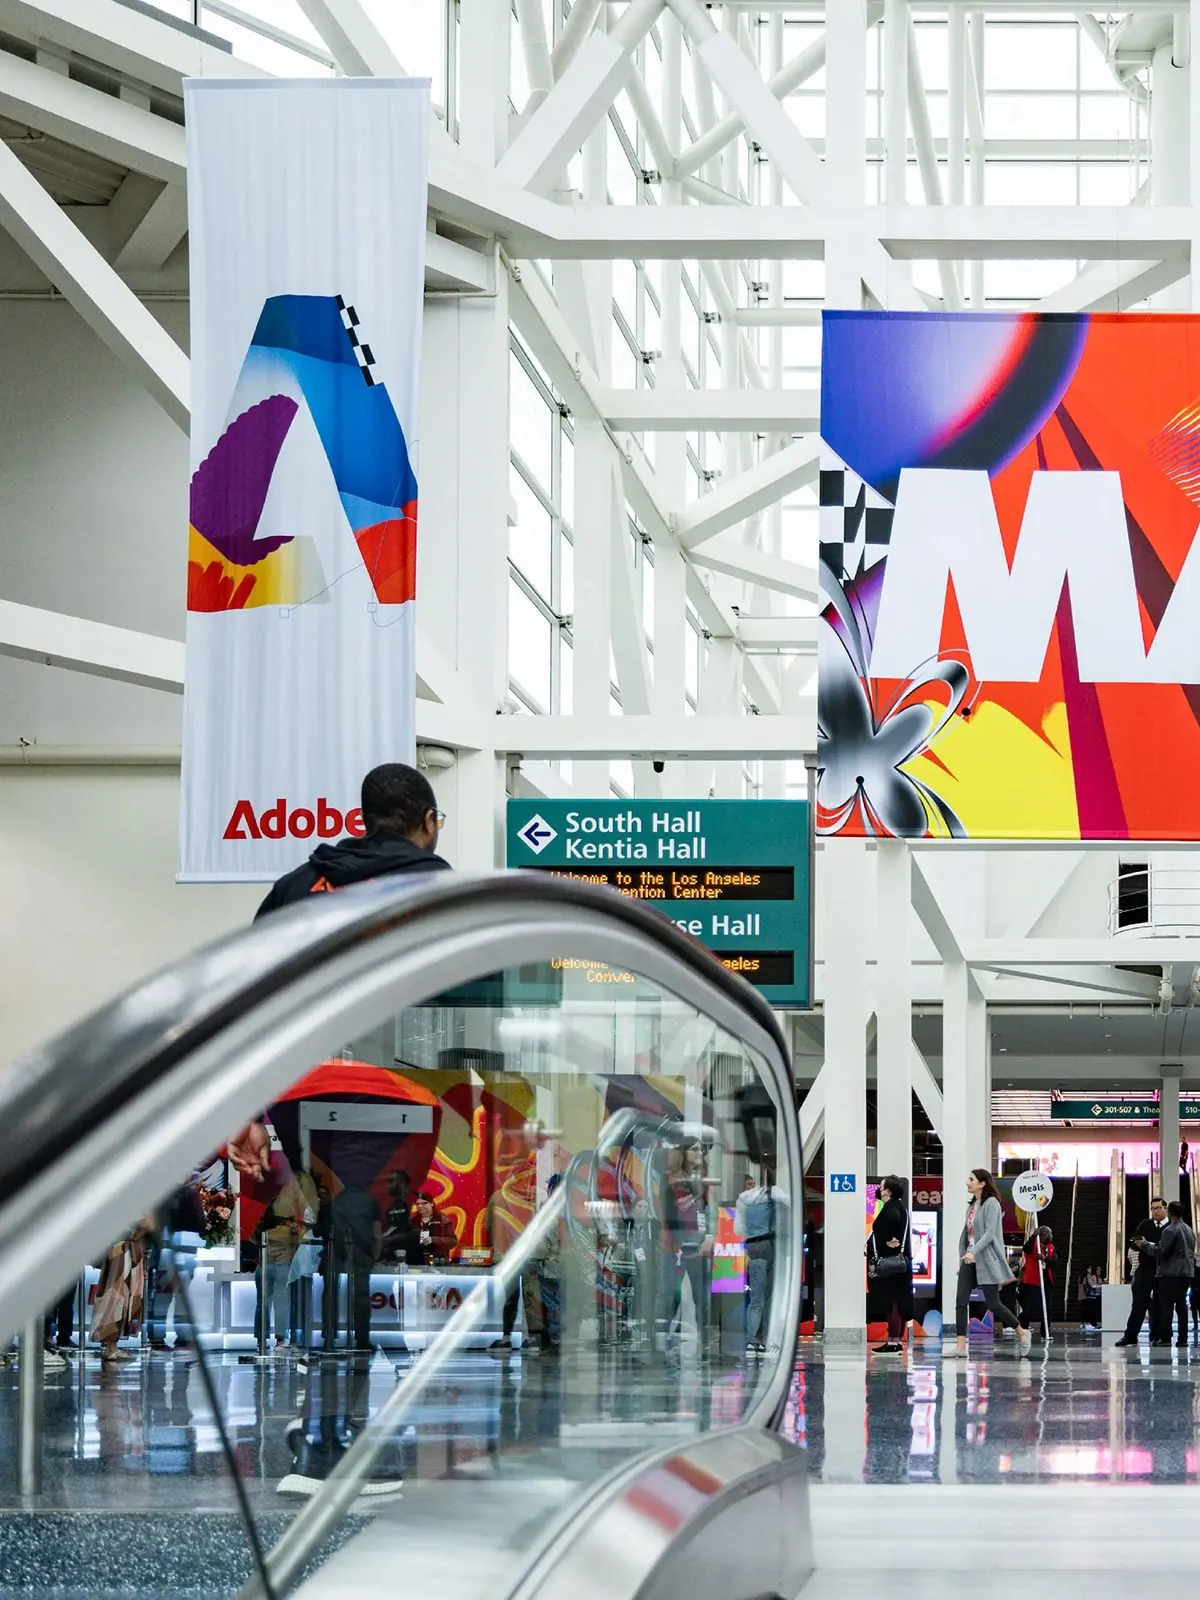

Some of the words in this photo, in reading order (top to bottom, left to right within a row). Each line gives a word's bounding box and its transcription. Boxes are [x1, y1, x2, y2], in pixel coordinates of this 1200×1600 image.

[222, 797, 368, 840] Adobe
[565, 811, 642, 833] South
[652, 811, 701, 833] Hall
[565, 838, 648, 859] Kentia
[658, 837, 706, 859] Hall
[616, 871, 632, 885] to
[640, 871, 664, 885] the
[671, 871, 698, 885] Los
[706, 871, 761, 886] Angeles
[673, 885, 723, 899] Center
[711, 914, 760, 936] Hall
[1103, 1106, 1133, 1114] 301-507
[1134, 1106, 1141, 1114] &
[1019, 1183, 1045, 1194] Meals
